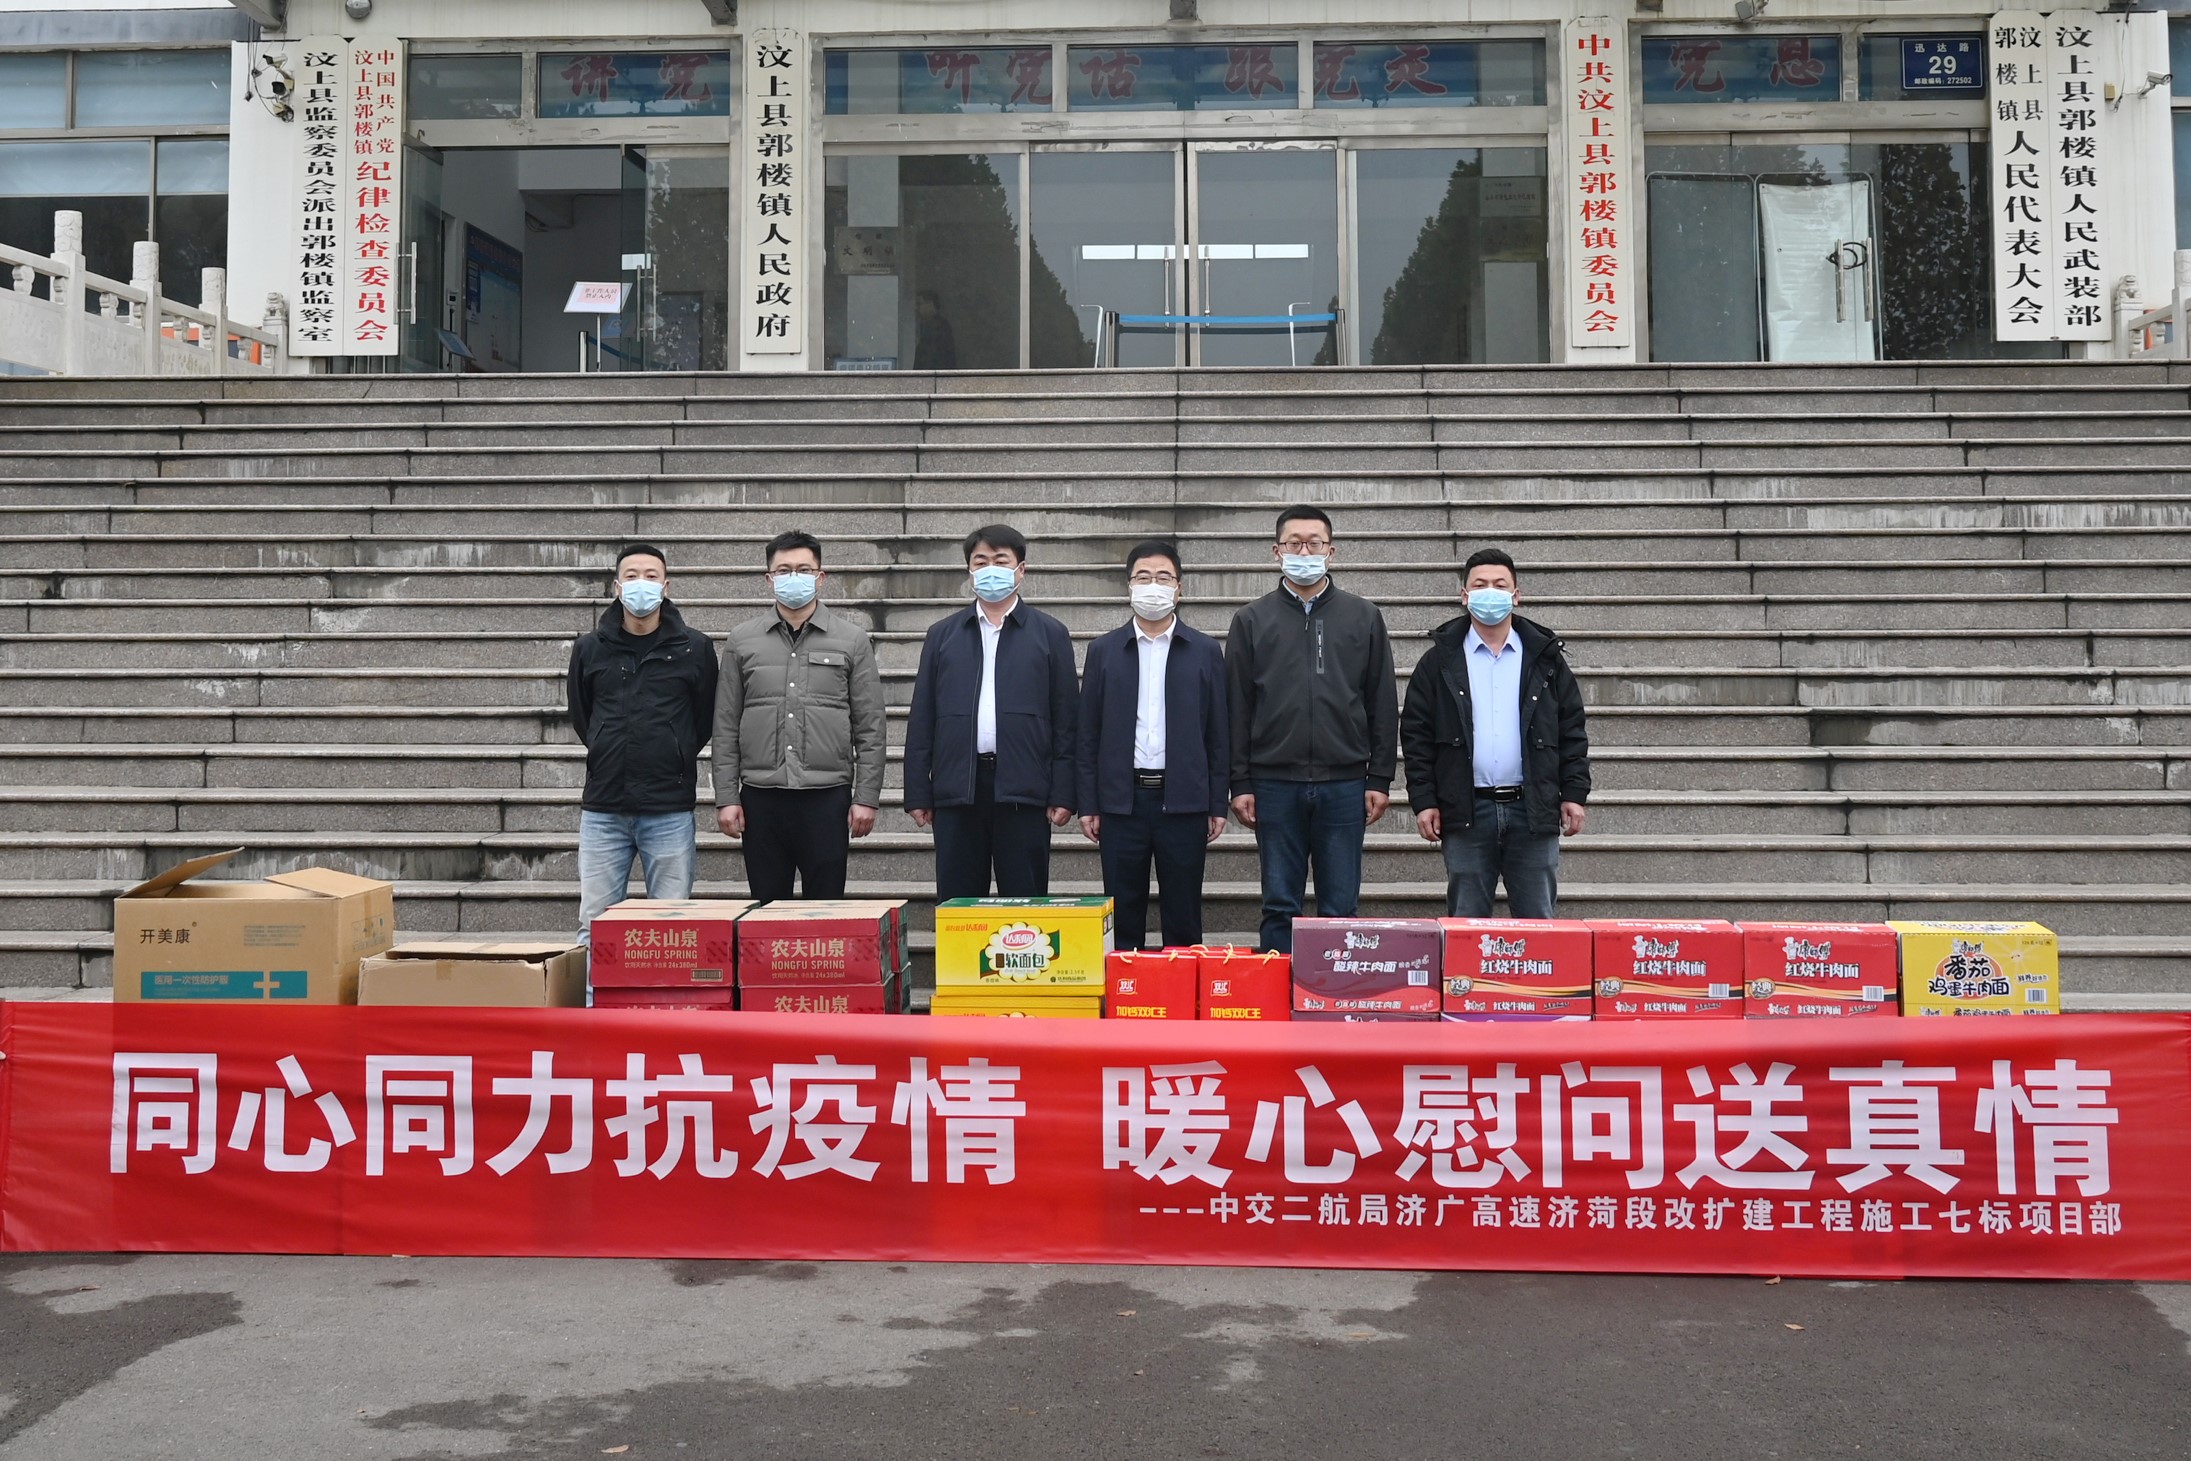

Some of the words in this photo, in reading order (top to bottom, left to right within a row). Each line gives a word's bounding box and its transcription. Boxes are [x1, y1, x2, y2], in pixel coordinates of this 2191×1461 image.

[1914, 42, 1970, 53] 迅达路
[1928, 55, 1957, 75] 29
[1995, 26, 2018, 121] 郭楼镇
[2020, 26, 2042, 121] 汶上县
[354, 51, 374, 153] 汶上县郭楼镇
[377, 51, 396, 152] 中国共产党
[1577, 33, 1620, 333] 中共汶上县郭楼镇委员会
[2055, 26, 2102, 327] 汶上县郭楼镇人民武装部
[300, 52, 337, 342] 汶上县监察委员会派出郭楼镇监察室
[756, 45, 793, 338] 汶上县郭楼镇人民政府
[2005, 130, 2043, 324] 人民代表大会
[354, 161, 394, 341] 纪律检查委员会
[140, 928, 190, 944] 开美康
[624, 928, 698, 948] 农夫山泉
[625, 950, 660, 959] NONGFU
[664, 950, 698, 959] SPRING
[771, 938, 845, 958] 农夫山泉
[1492, 936, 1526, 957] 康师傅
[1646, 938, 1679, 958] 康师傅
[1798, 939, 1830, 960] 康师傅
[772, 960, 807, 970] NONGFU
[811, 960, 845, 970] SPRING
[1006, 953, 1045, 968] 软面包
[1333, 961, 1397, 975] 酸辣牛肉面
[1481, 959, 1553, 975] 红烧牛肉面
[1633, 960, 1706, 976] 红烧牛肉面
[1785, 962, 1860, 979] 红烧牛肉面
[1944, 955, 1991, 980] 番茄
[154, 975, 229, 985] 医用一次性防护服
[1450, 979, 1471, 990] 经典
[1600, 981, 1620, 991] 经典
[1752, 982, 1772, 993] 经典
[1928, 976, 2010, 997] 鸡蛋牛肉面
[774, 995, 848, 1013] 农夫山泉
[110, 1051, 1027, 1184] 同心同力抗疫情
[1102, 1060, 2119, 1197] 暖心慰问送真情
